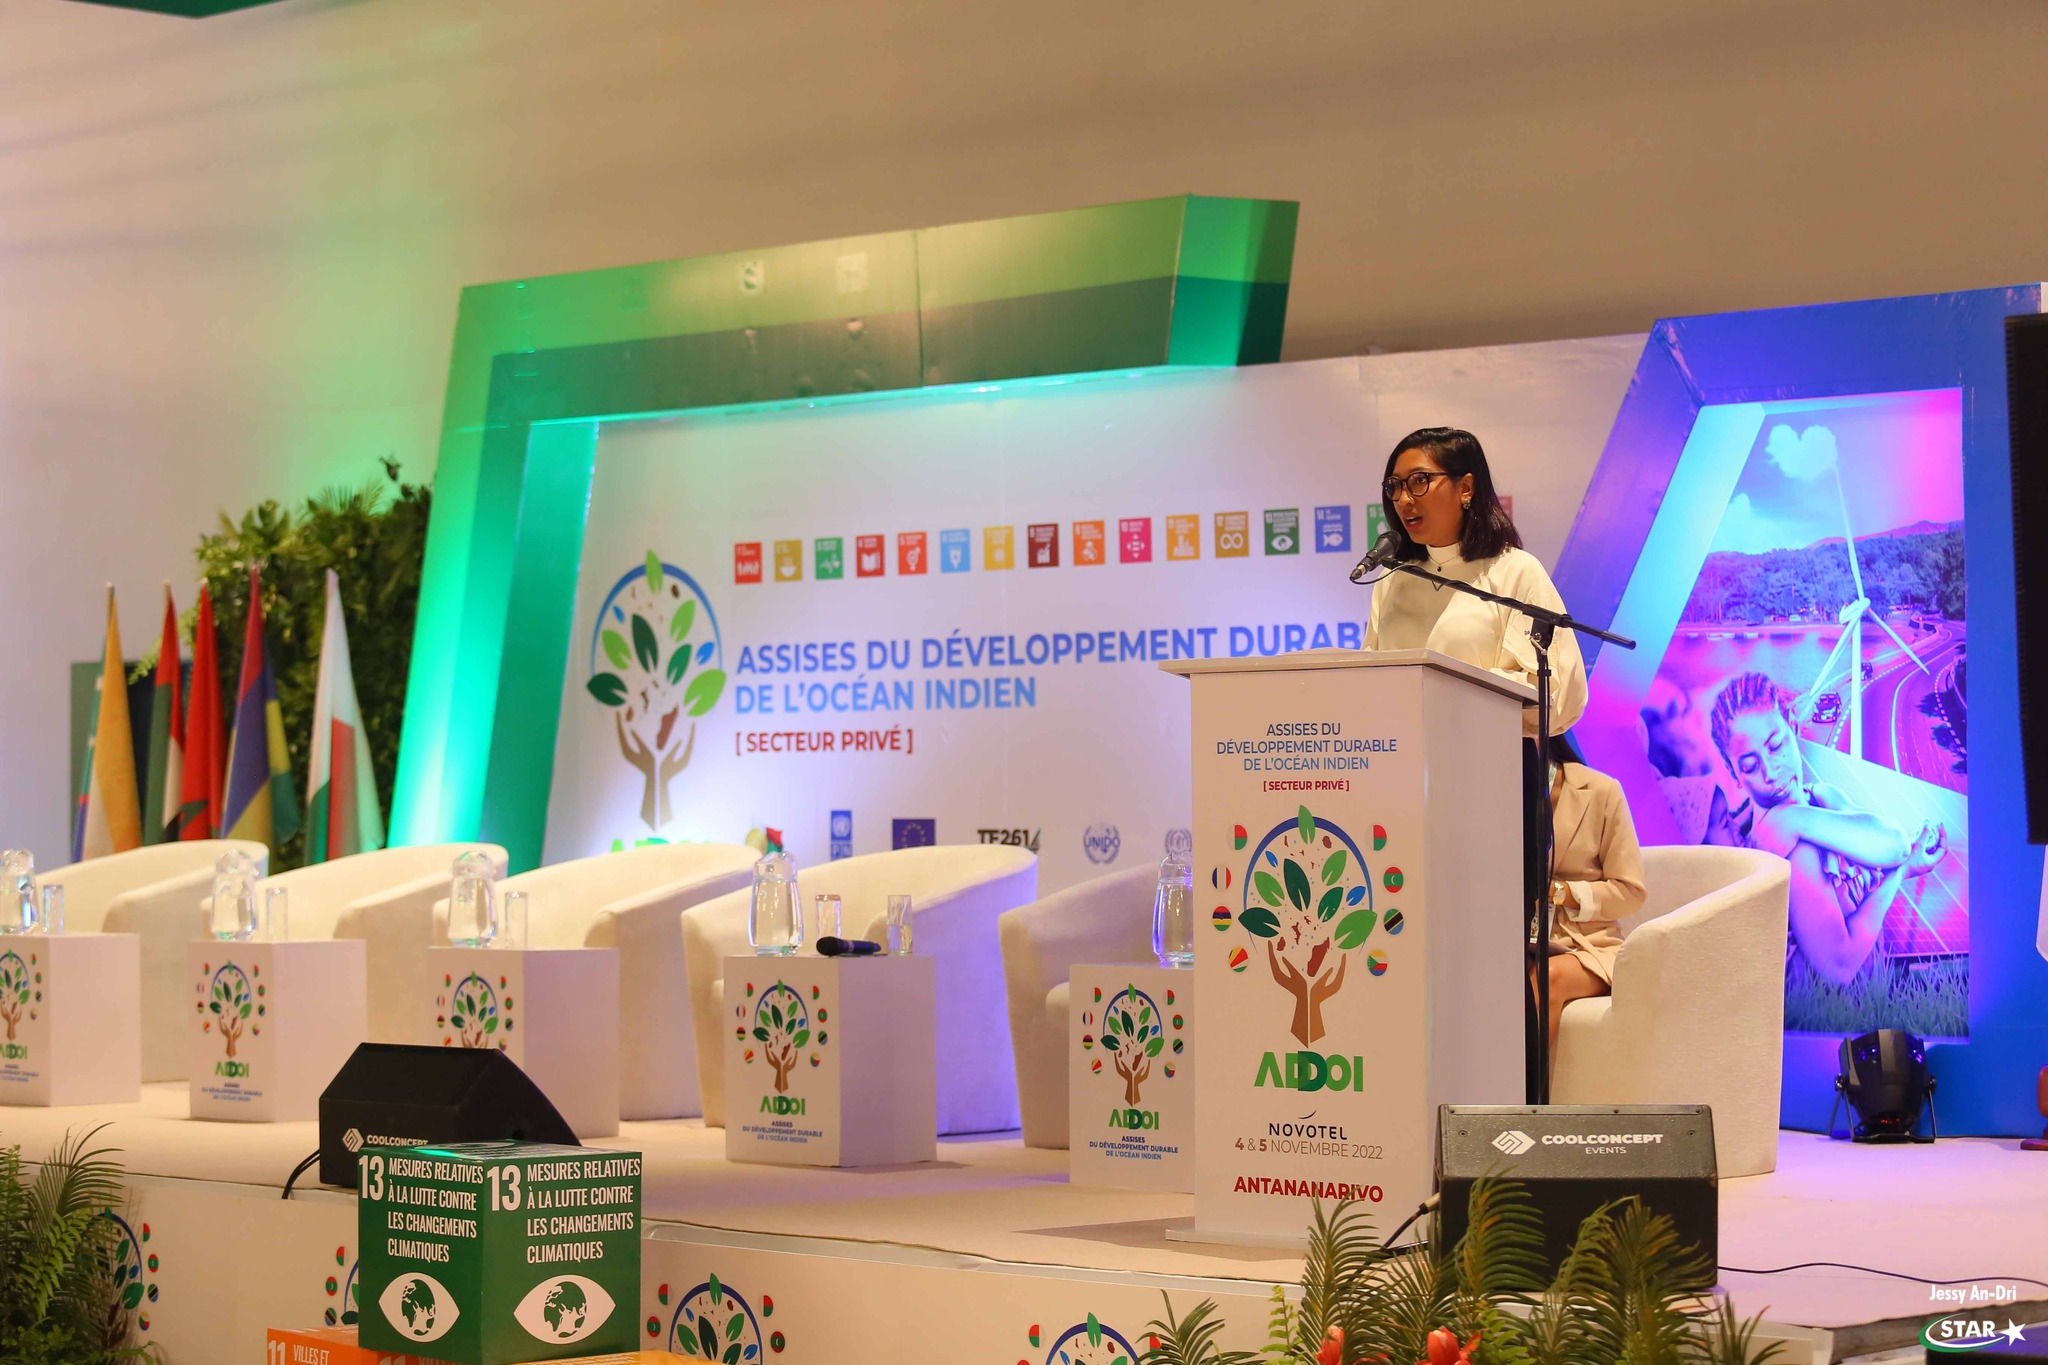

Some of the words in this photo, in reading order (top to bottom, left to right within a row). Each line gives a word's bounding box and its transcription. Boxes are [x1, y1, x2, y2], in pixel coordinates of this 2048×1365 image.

[736, 642, 857, 675] ASSISES
[867, 640, 911, 670] DU
[922, 627, 1217, 669] DÉVELOPPEMENT
[1230, 622, 1367, 657] DURAB
[736, 684, 774, 714] DE
[784, 674, 914, 712] L'OCÉAN
[926, 677, 1036, 710] INDIEN
[1266, 723, 1318, 736] ASSISES
[1321, 722, 1341, 736] DU
[1216, 739, 1331, 755] DÉVELOPPEMENT
[1333, 739, 1397, 753] DURABLE
[1243, 758, 1262, 771] DE
[1264, 755, 1320, 771] L'OCÉAN
[1323, 757, 1369, 770] INDIEN
[1083, 835, 1121, 850] UNIDO
[215, 1061, 250, 1078] ADDOI
[1253, 1050, 1364, 1092] ADDOI
[760, 1095, 806, 1116] ADDOI
[771, 1120, 793, 1128] ASSISES
[1108, 1108, 1160, 1131] ADDOI
[1269, 1122, 1348, 1140] NOVOTEL
[366, 1134, 429, 1146] COOLCONCEPT
[1099, 1141, 1149, 1152] DÉVELOPPEMENT
[1150, 1145, 1178, 1153] DURABLE
[1235, 1137, 1245, 1151] 4
[1247, 1137, 1256, 1151] &
[1259, 1138, 1267, 1152] 5
[1271, 1139, 1349, 1158] NOVEMBRE
[1352, 1144, 1383, 1160] 2022
[1541, 1133, 1664, 1145] COOLCONCEPT
[1585, 1146, 1627, 1155] EVENTS
[1115, 1150, 1140, 1159] L'OCÉAN
[1141, 1152, 1161, 1160] INDIEN
[359, 1155, 385, 1201] 13
[388, 1157, 432, 1179] MESURES
[434, 1162, 484, 1184] RELATIVES
[527, 1161, 581, 1182] MESURES
[583, 1158, 641, 1179] RELATIVES
[388, 1179, 395, 1202] À
[396, 1185, 408, 1204] LA
[410, 1186, 437, 1207] LUTTE
[439, 1190, 477, 1211] CONTRE
[486, 1164, 521, 1211] 13
[527, 1186, 535, 1210] À
[538, 1190, 552, 1209] LA
[555, 1188, 588, 1208] LUTTE
[590, 1185, 634, 1205] CONTRE
[1234, 1176, 1384, 1203] ANTANANARIVO
[388, 1211, 404, 1230] LES
[406, 1213, 477, 1239] CHANGEMENTS
[527, 1218, 548, 1237] LES
[550, 1212, 634, 1235] CHANGEMENTS
[388, 1238, 450, 1263] CLIMATIQUES
[527, 1241, 604, 1264] CLIMATIQUES
[268, 1340, 286, 1365] 11
[293, 1344, 319, 1365] VILLES
[320, 1350, 330, 1365] ET
